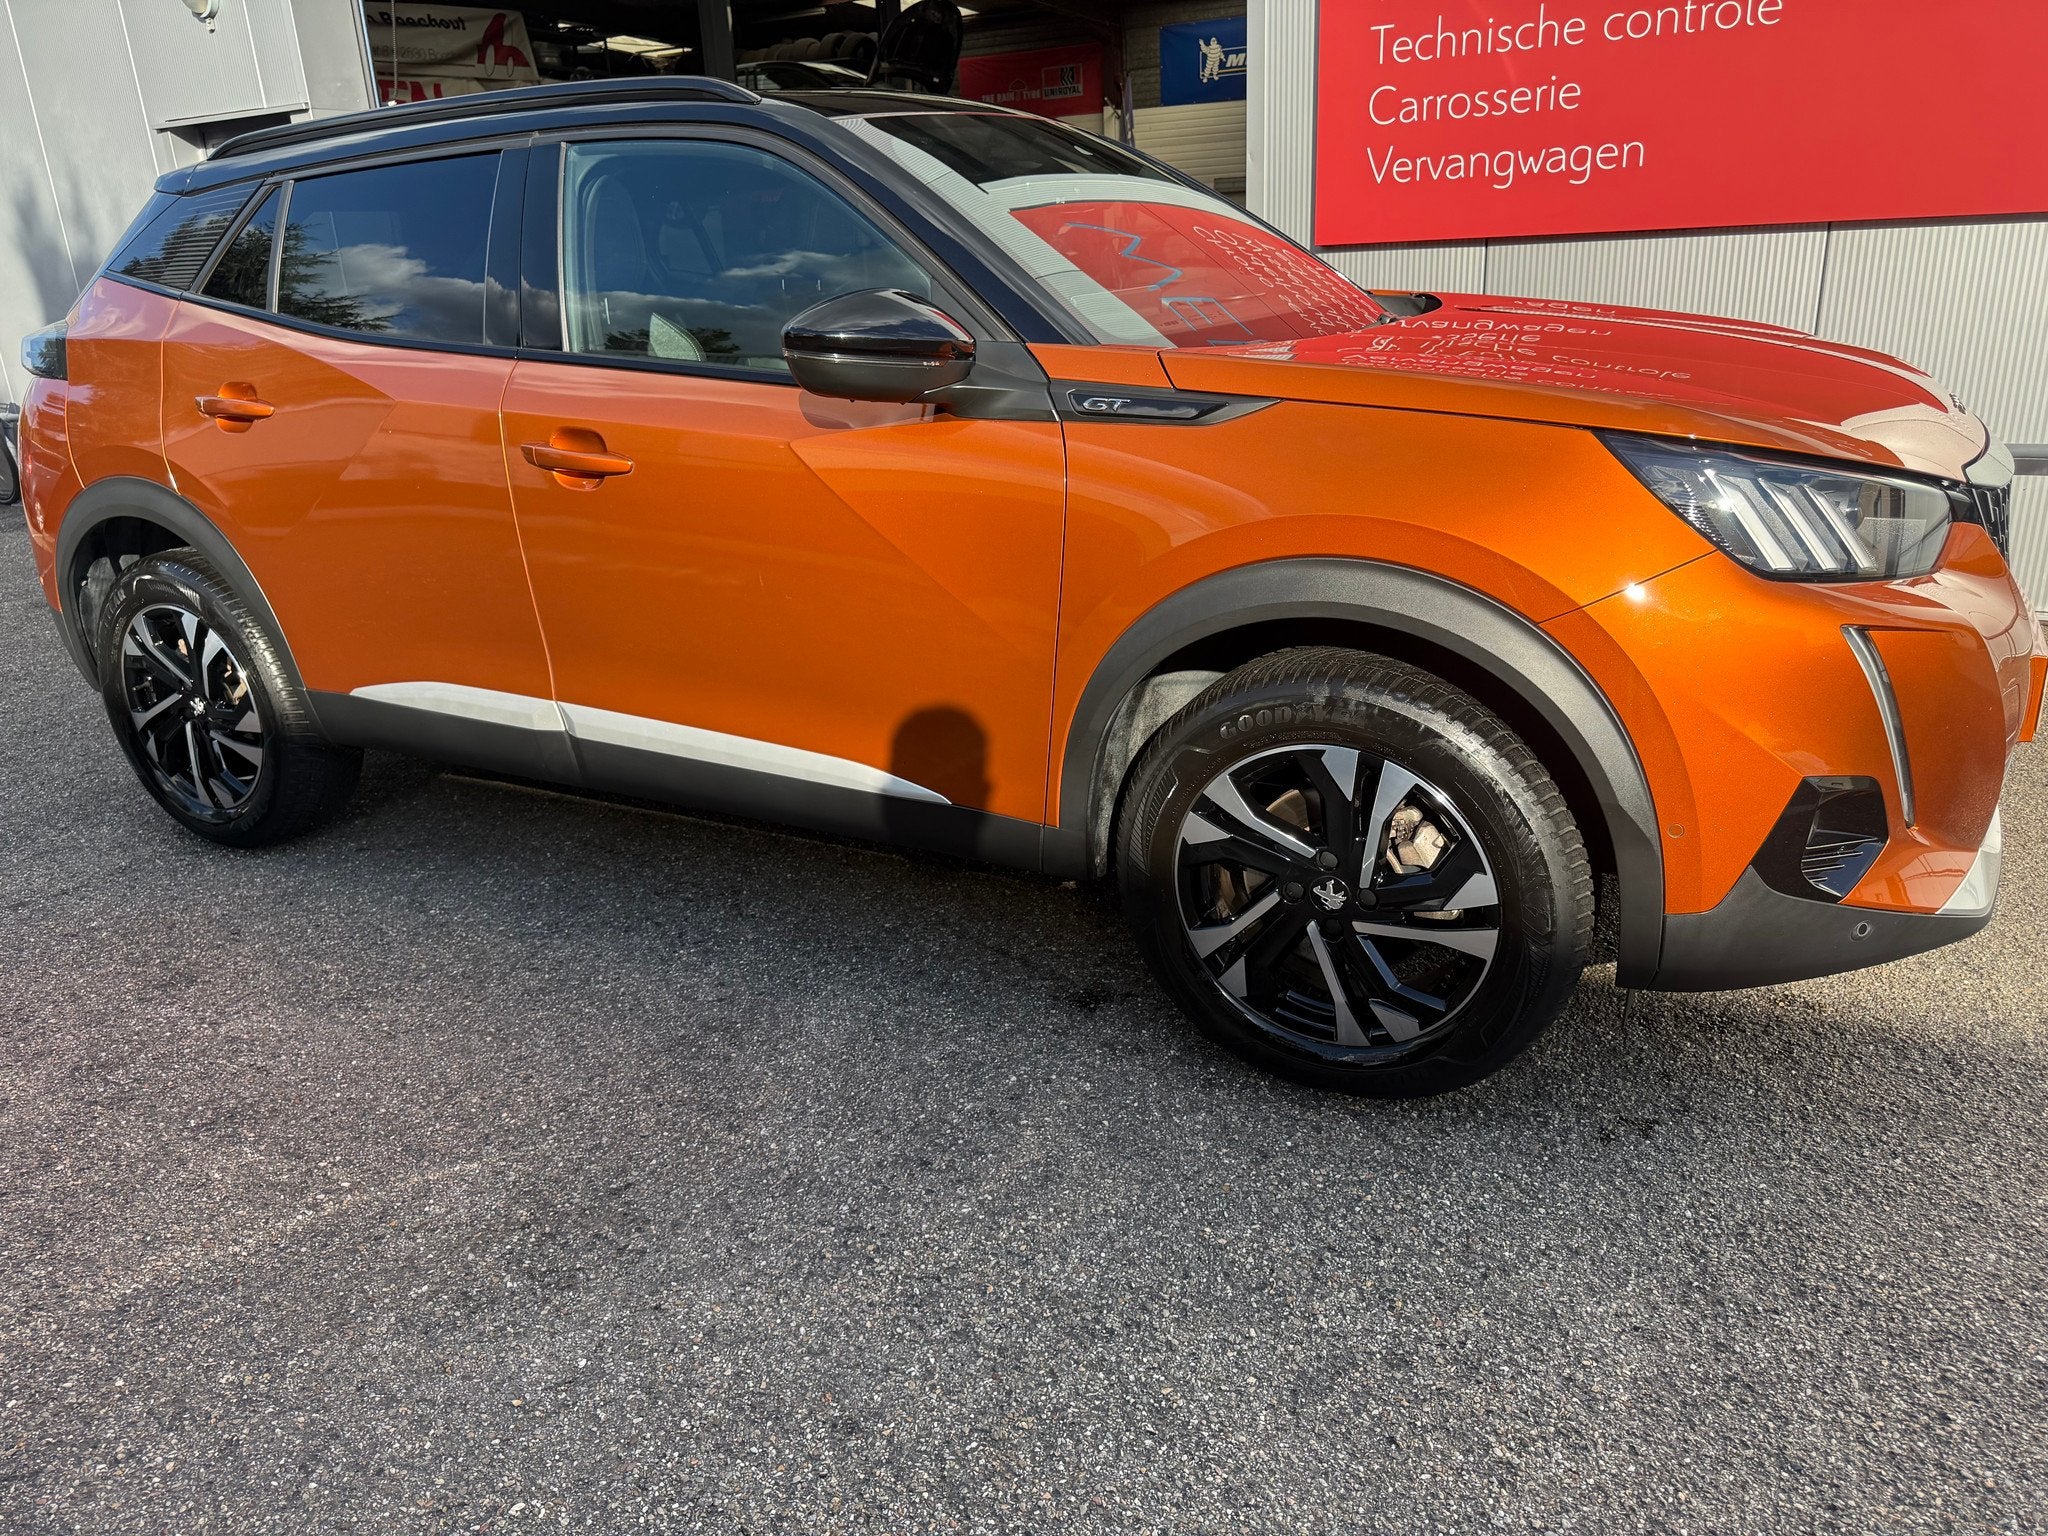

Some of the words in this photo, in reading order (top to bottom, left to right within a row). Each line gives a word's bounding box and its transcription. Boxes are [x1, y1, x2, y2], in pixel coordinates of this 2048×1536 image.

[1371, 3, 1586, 65] Technische
[1603, 0, 1783, 41] controle
[1023, 89, 1042, 101] TYRE
[1043, 85, 1082, 97] UNIROYAL
[1369, 75, 1581, 125] Carrosserie
[1366, 141, 1644, 189] Vervangwagen
[1082, 397, 1131, 412] GT
